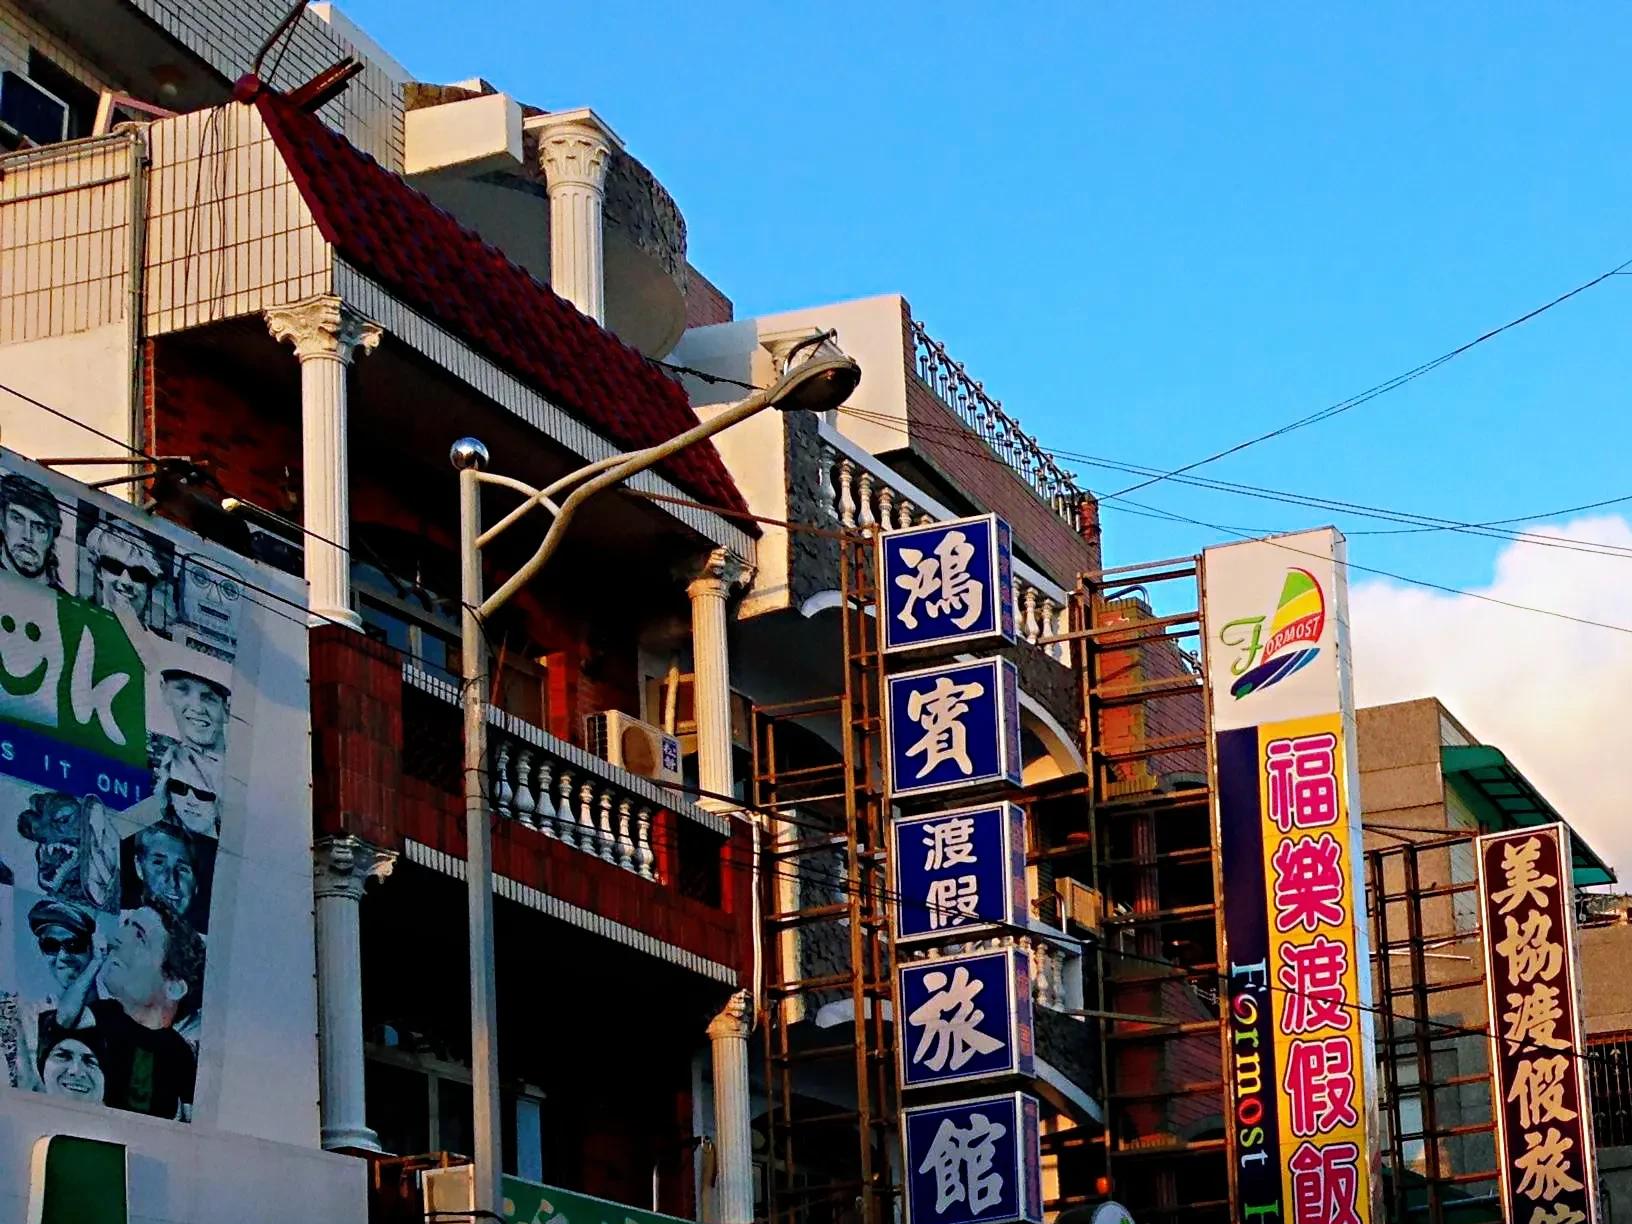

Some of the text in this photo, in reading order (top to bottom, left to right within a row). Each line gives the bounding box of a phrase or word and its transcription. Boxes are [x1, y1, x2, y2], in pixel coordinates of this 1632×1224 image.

[894, 530, 1007, 1217] 鴻賓渡假旅館
[1231, 960, 1268, 1168] Formost
